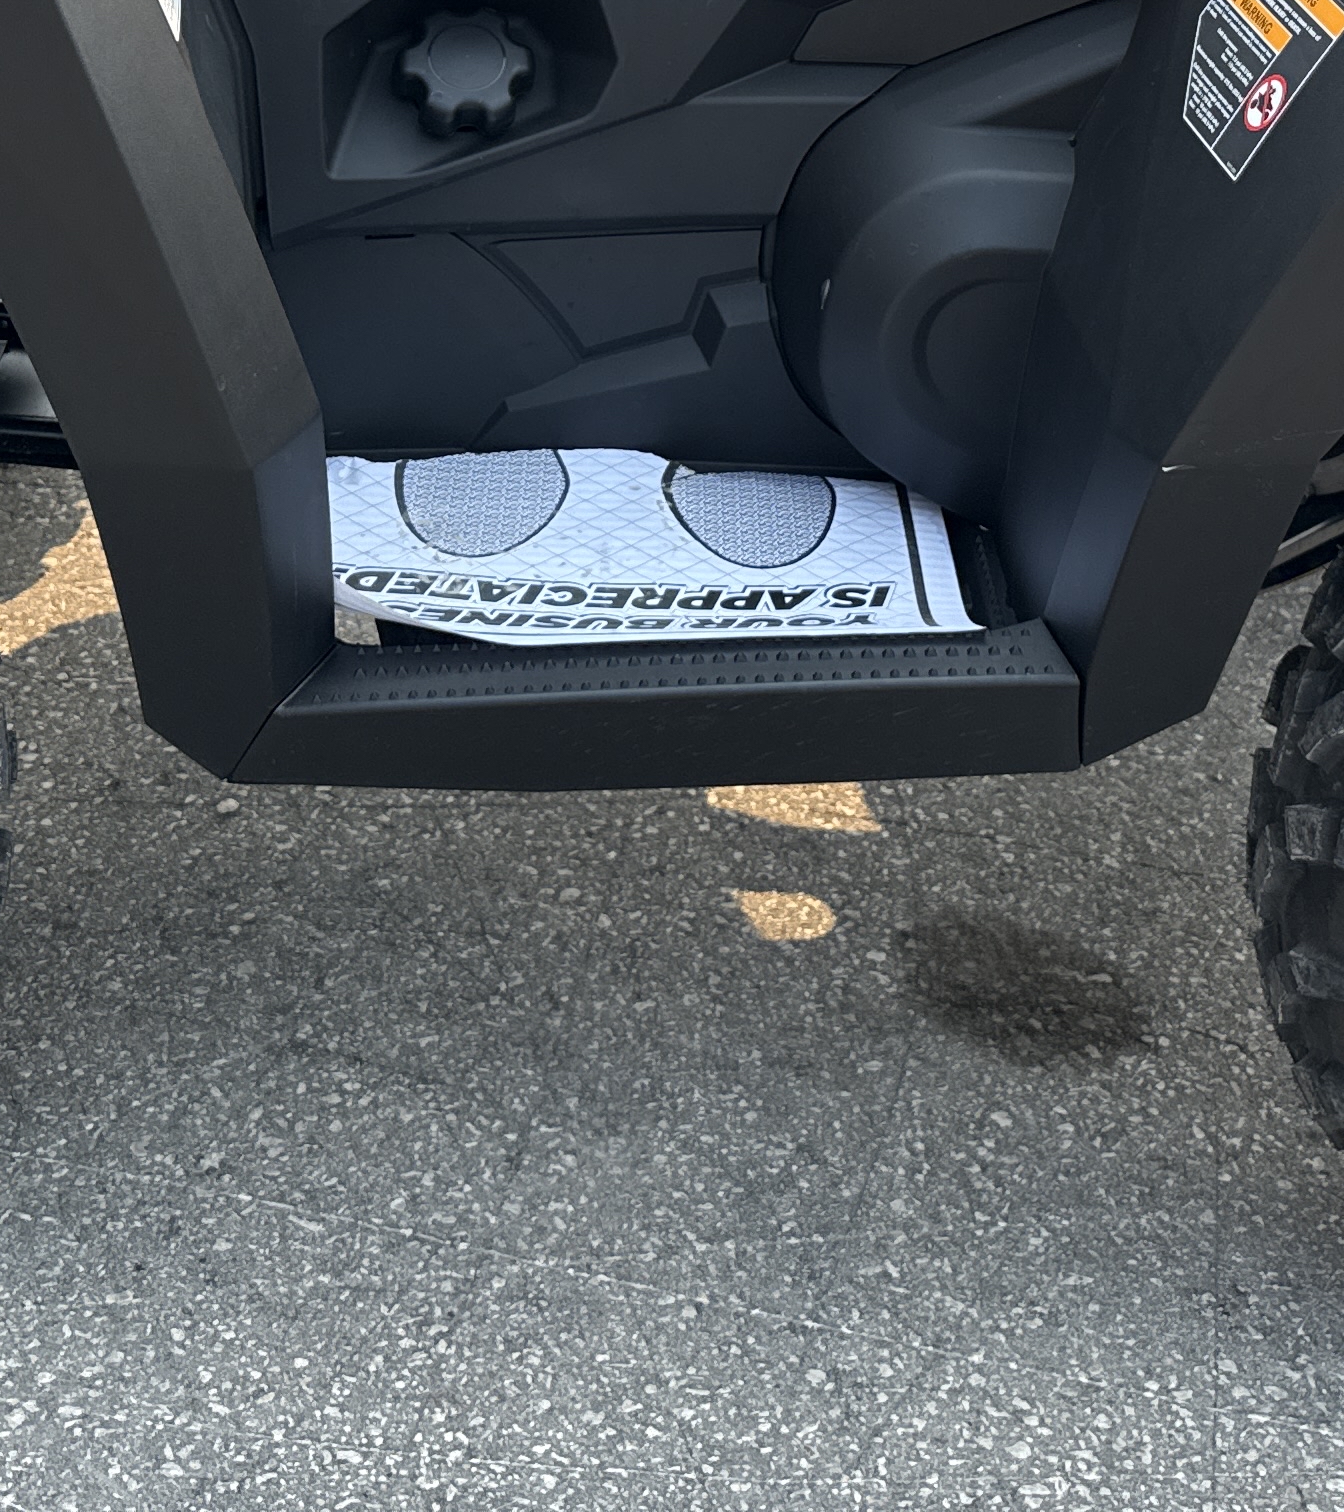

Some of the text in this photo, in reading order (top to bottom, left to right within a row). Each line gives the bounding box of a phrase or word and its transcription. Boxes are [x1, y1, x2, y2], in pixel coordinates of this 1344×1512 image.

[826, 584, 892, 609] IS
[391, 600, 879, 631] YOUR BUSINE
